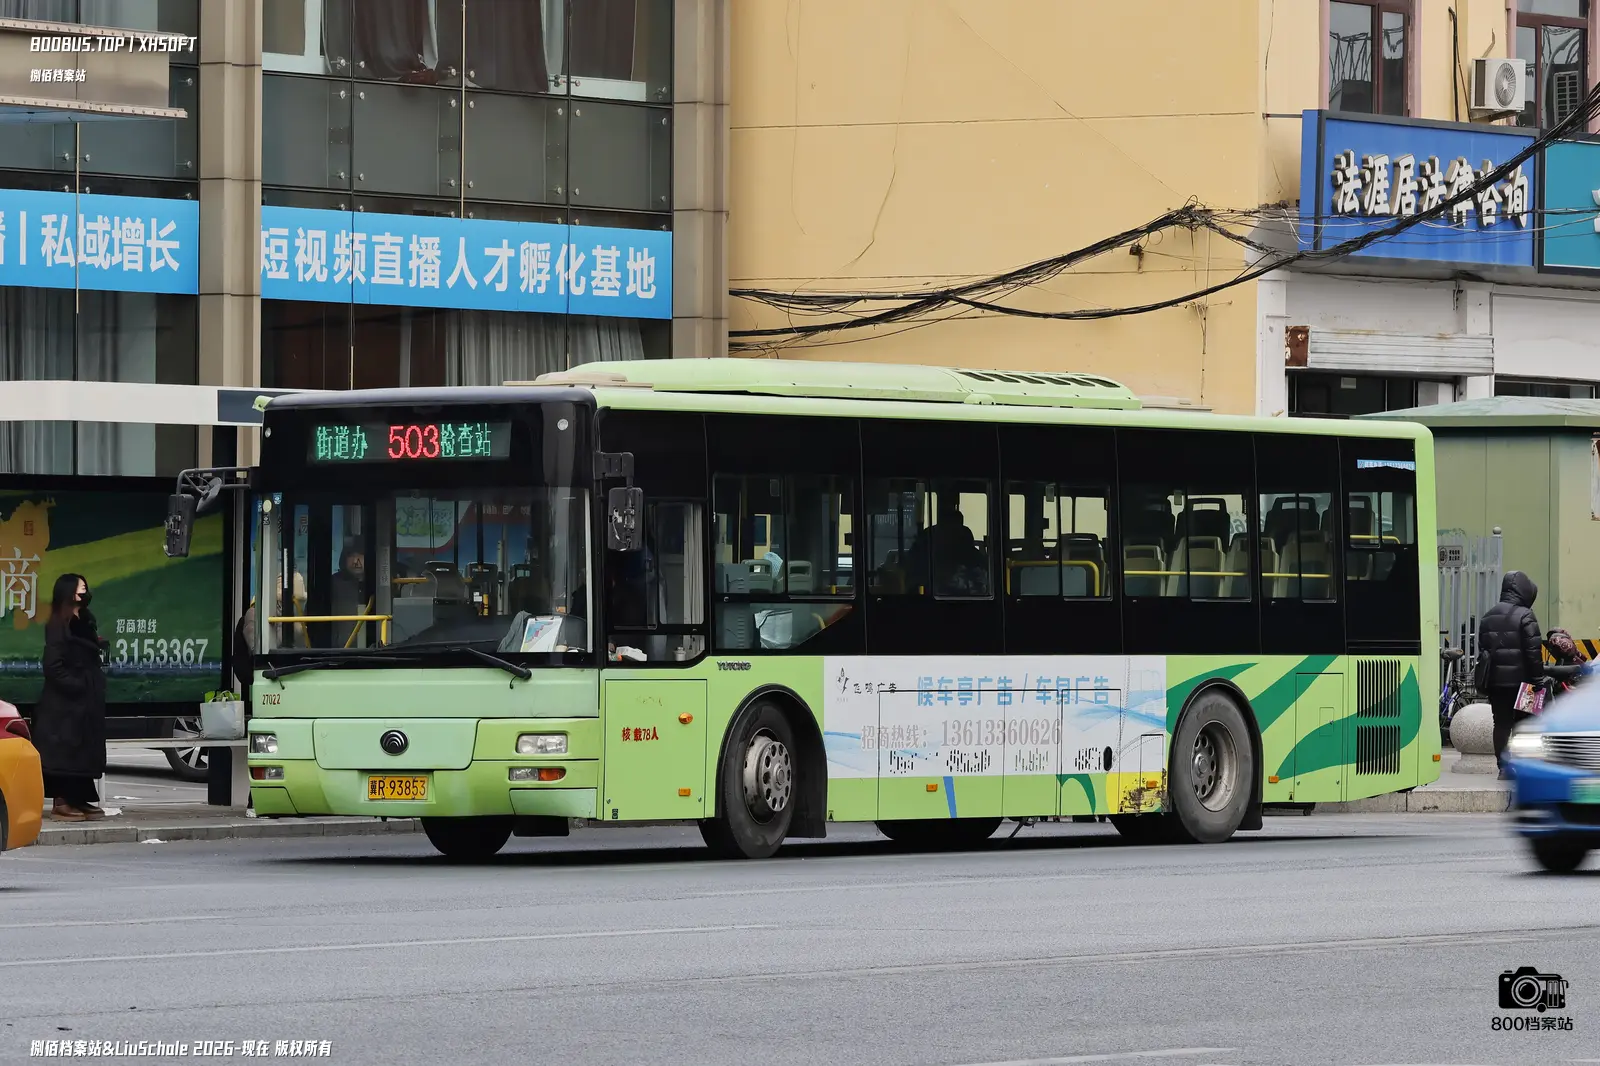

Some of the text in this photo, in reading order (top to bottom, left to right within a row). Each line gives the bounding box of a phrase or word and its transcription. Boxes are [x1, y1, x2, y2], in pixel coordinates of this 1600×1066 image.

[261, 226, 657, 299] 短视频直播人才孵化基地
[316, 425, 368, 460] 街道办
[0, 547, 41, 619] 商
[116, 619, 157, 634] 招商热线
[115, 638, 208, 666] 3153367
[261, 694, 281, 704] 27022
[916, 675, 1013, 706] 候车亭广告
[1035, 674, 1111, 705] 车身广告
[940, 718, 1062, 748] 13613360626
